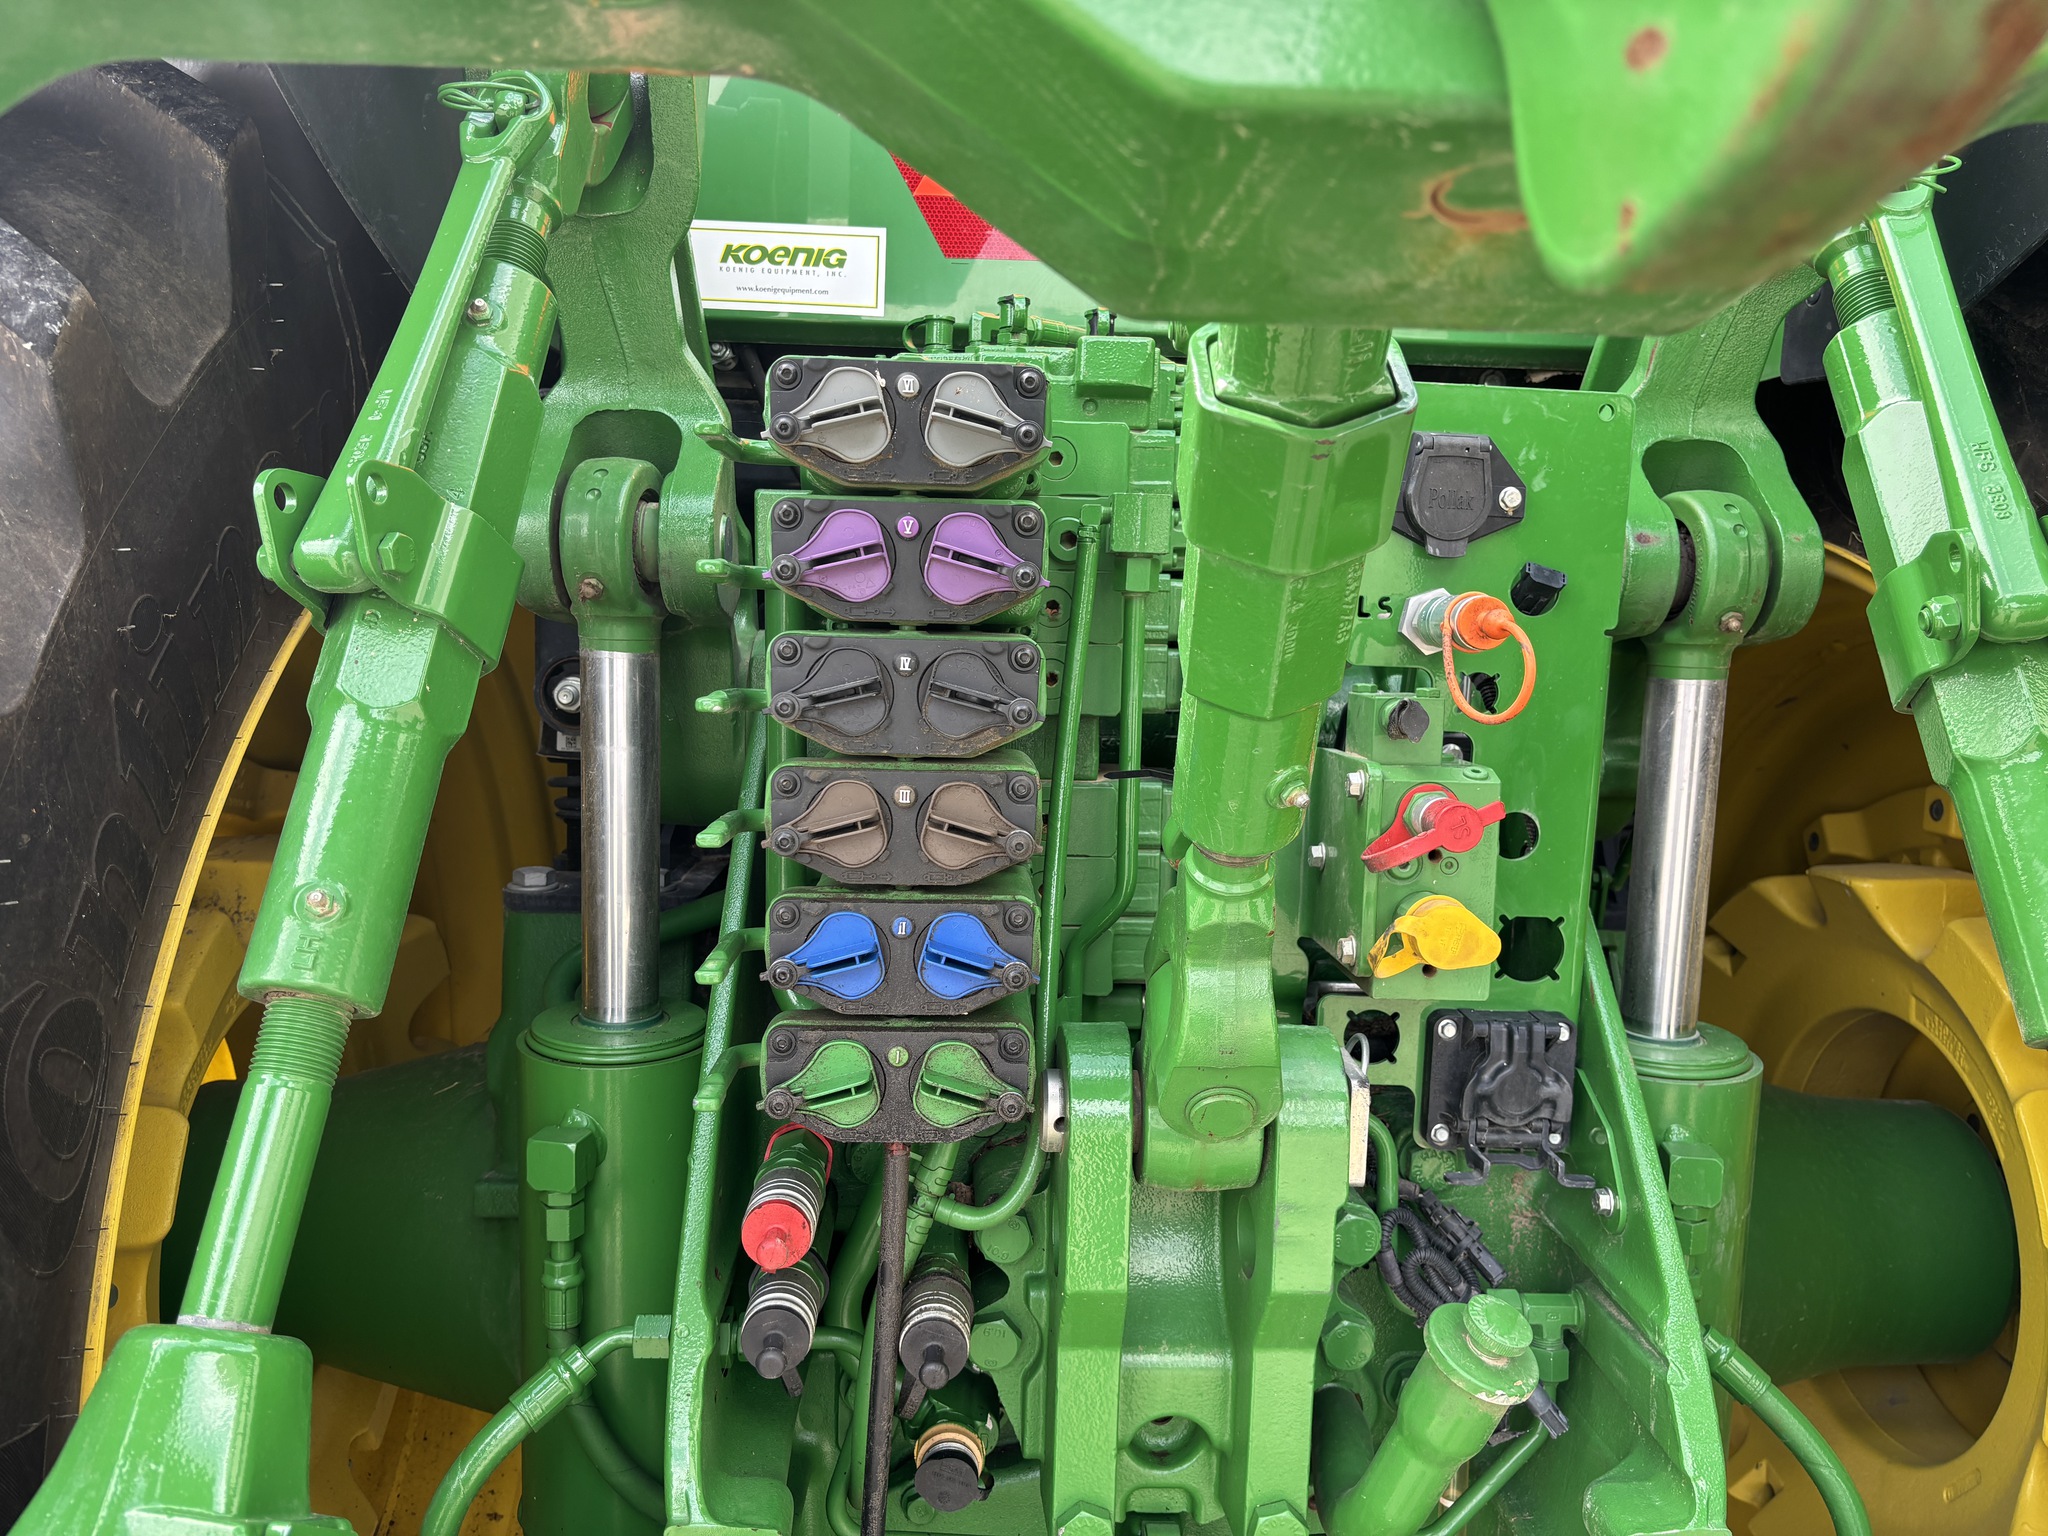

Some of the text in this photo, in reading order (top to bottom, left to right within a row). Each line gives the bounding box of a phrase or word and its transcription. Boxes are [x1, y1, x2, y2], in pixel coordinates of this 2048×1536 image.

[719, 266, 847, 278] KOENIG EQUIPMENT, INC.
[736, 285, 829, 295] www.koenigequipment.com
[902, 378, 915, 393] VI
[1428, 488, 1475, 511] Pollak
[902, 520, 914, 534] V
[1357, 595, 1393, 619] LS
[900, 656, 911, 671] IV
[899, 790, 911, 804] III
[897, 921, 907, 935] II
